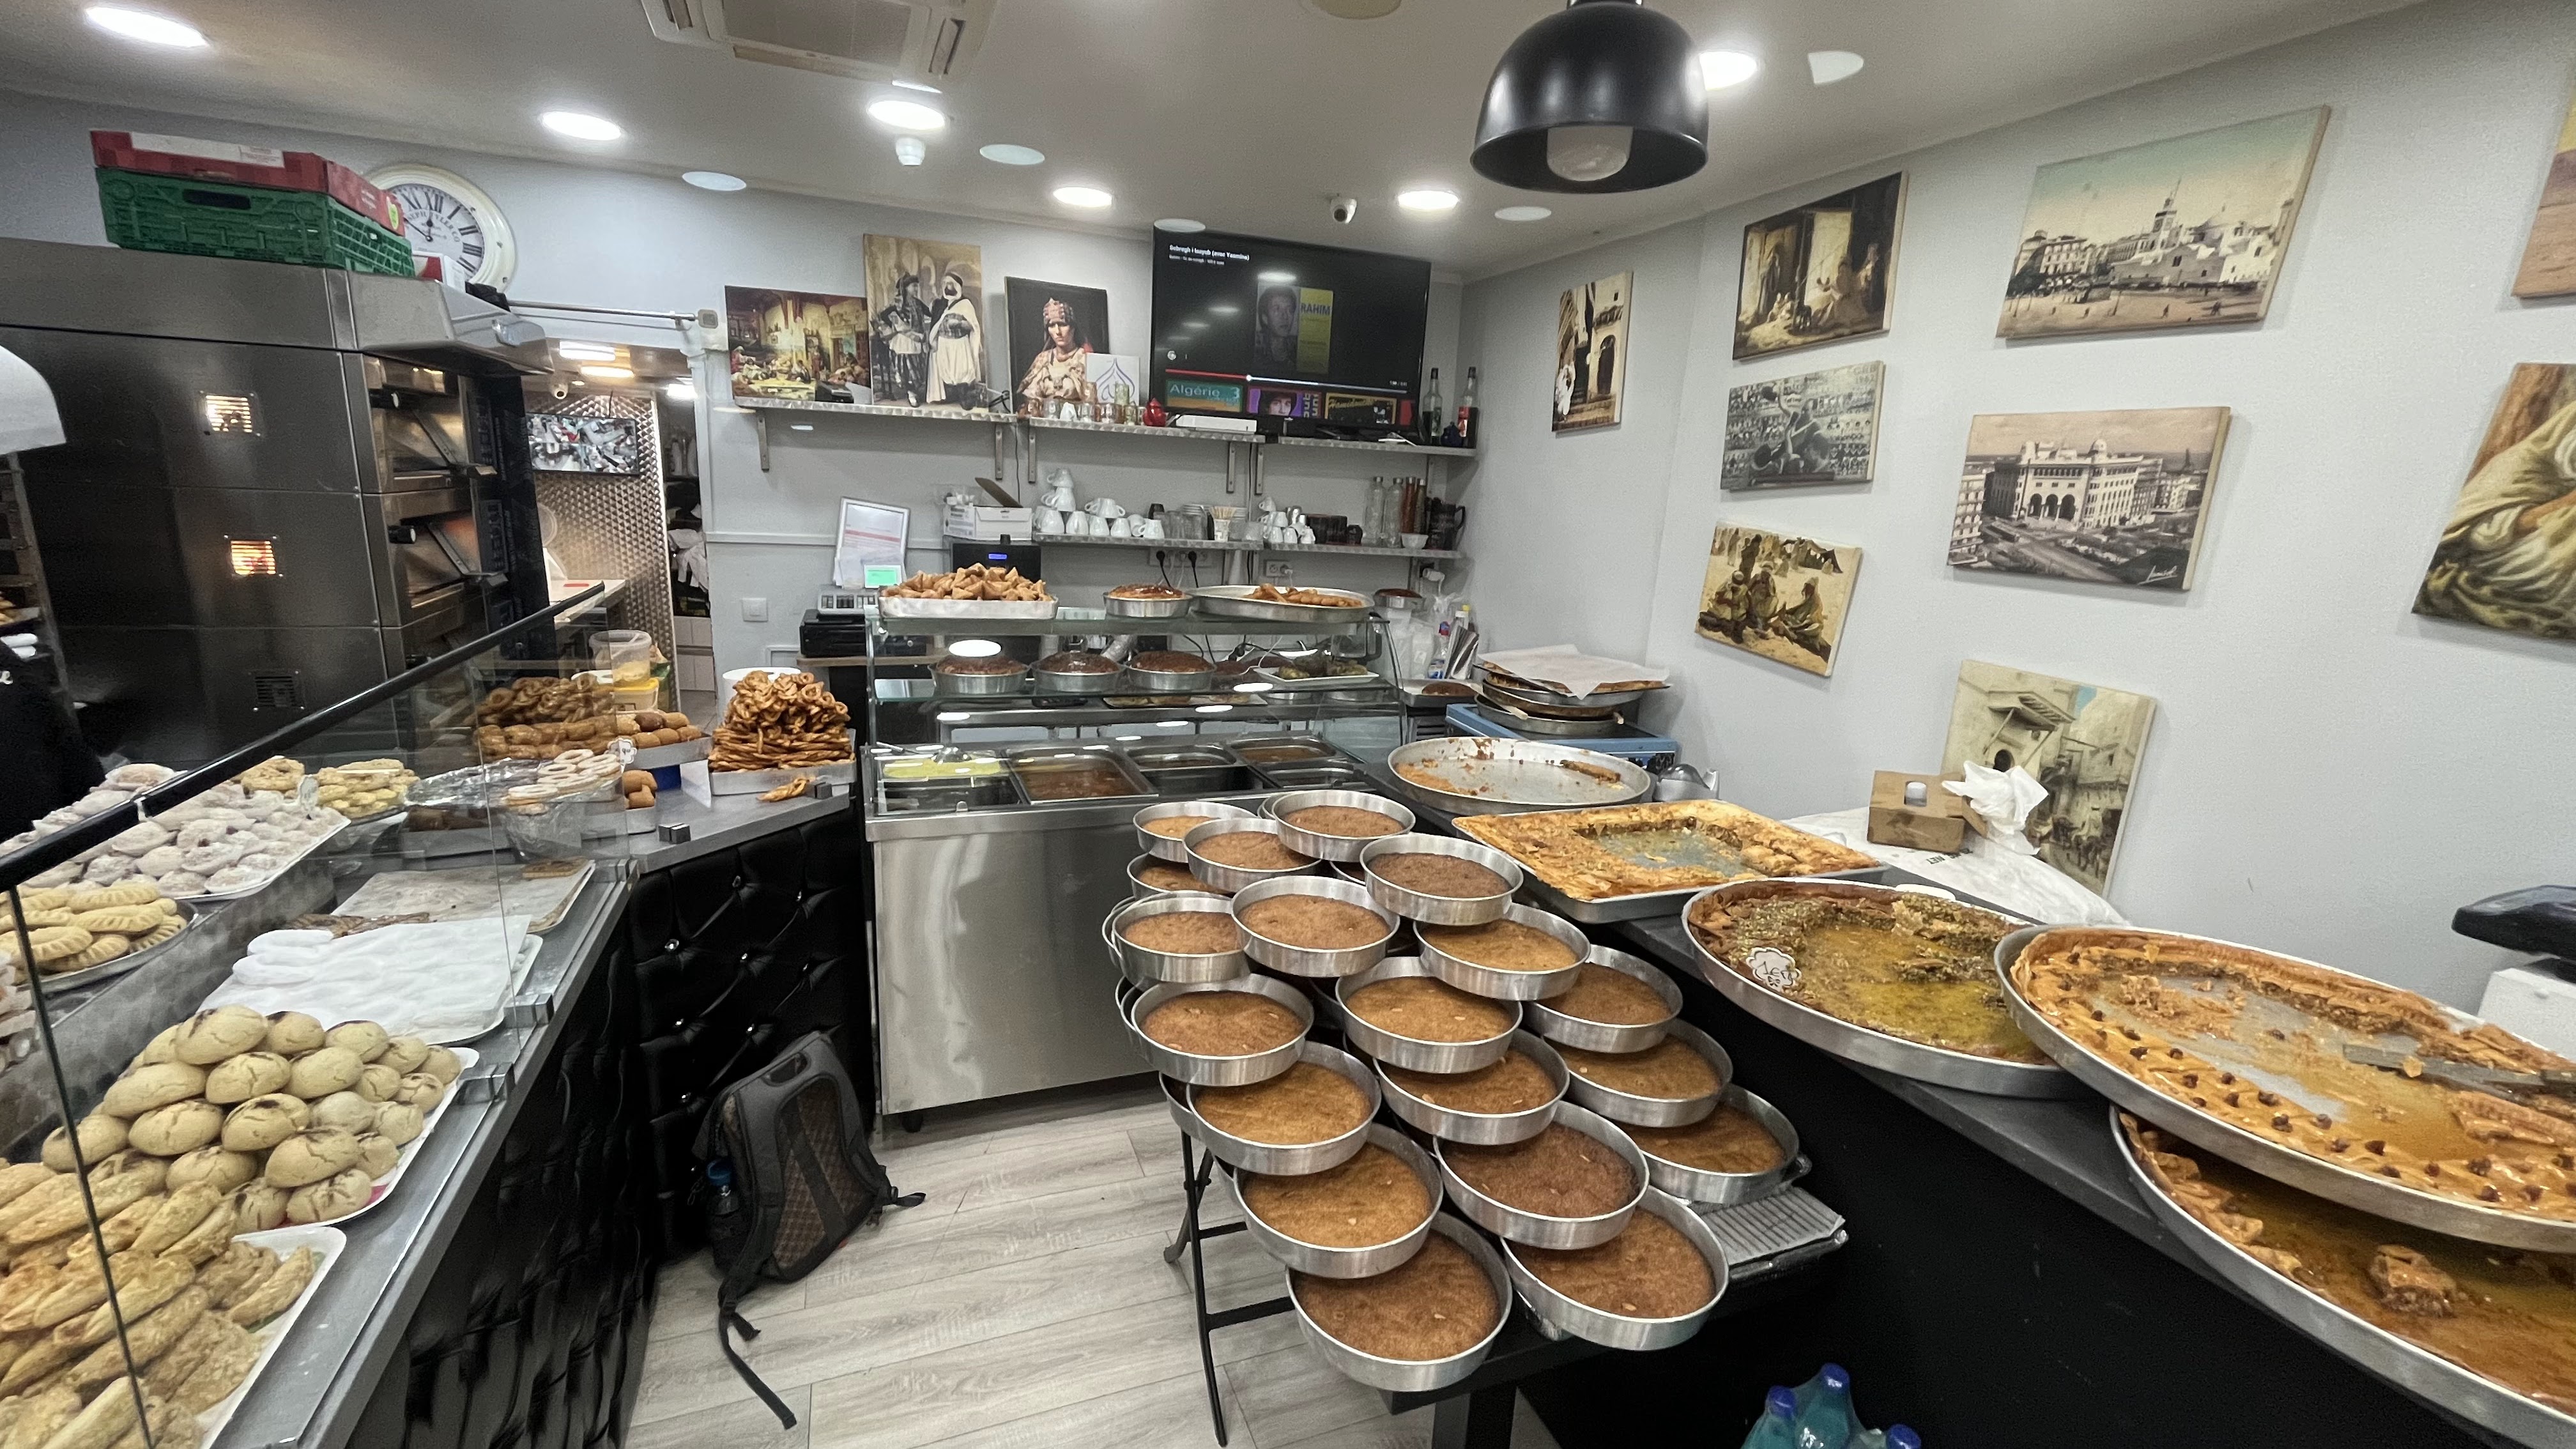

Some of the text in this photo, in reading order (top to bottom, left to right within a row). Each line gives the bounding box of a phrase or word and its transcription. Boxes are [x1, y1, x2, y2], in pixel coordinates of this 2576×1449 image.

[1300, 303, 1330, 315] RAHIM
[1170, 385, 1220, 397] Algérie
[1926, 855, 1945, 864] NET
